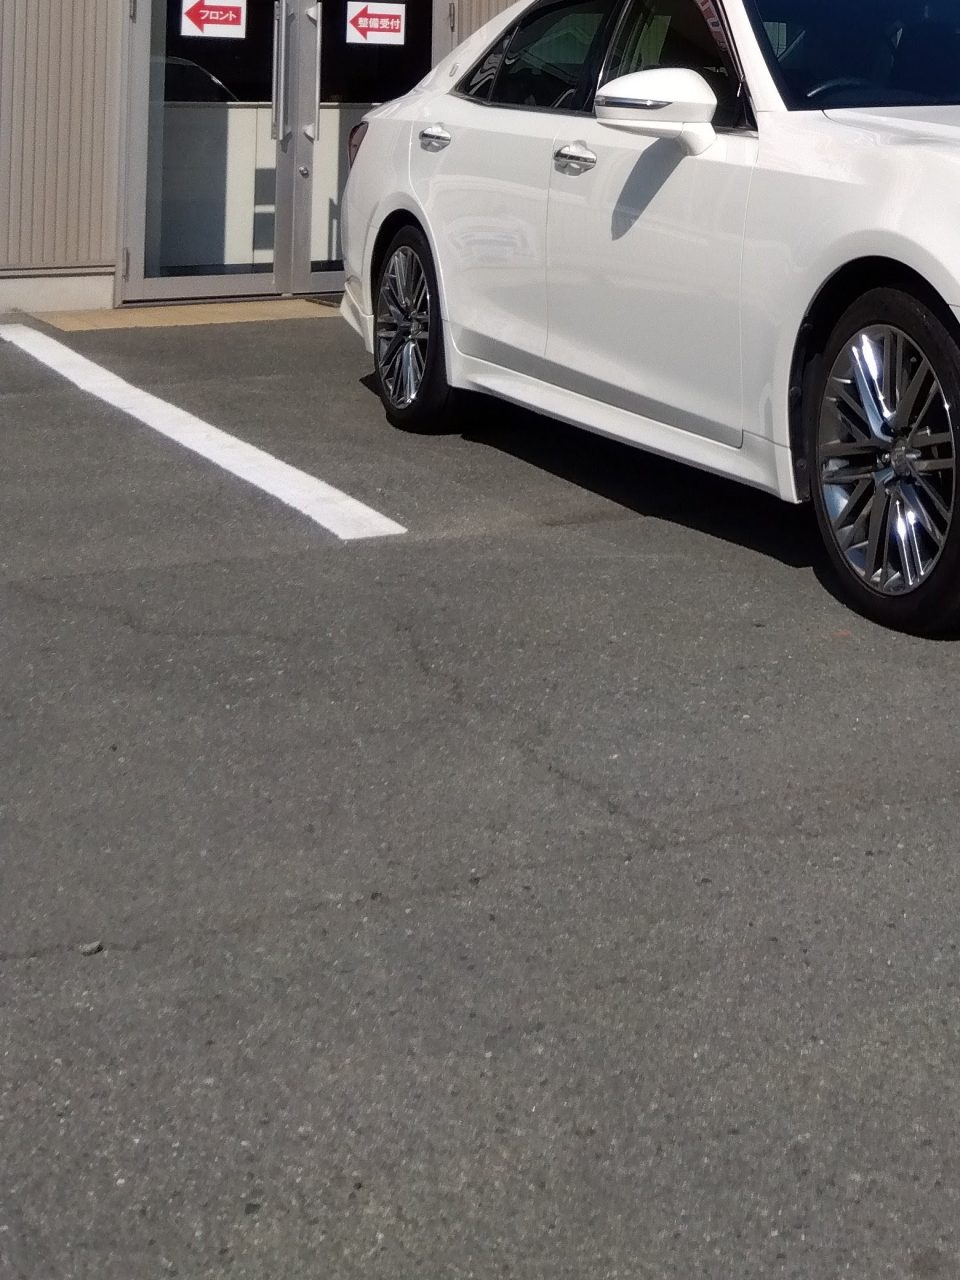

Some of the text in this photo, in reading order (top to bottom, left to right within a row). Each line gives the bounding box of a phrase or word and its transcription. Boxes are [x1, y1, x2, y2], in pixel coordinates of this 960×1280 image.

[199, 9, 238, 22] フロント
[357, 17, 401, 30] 整備受付
